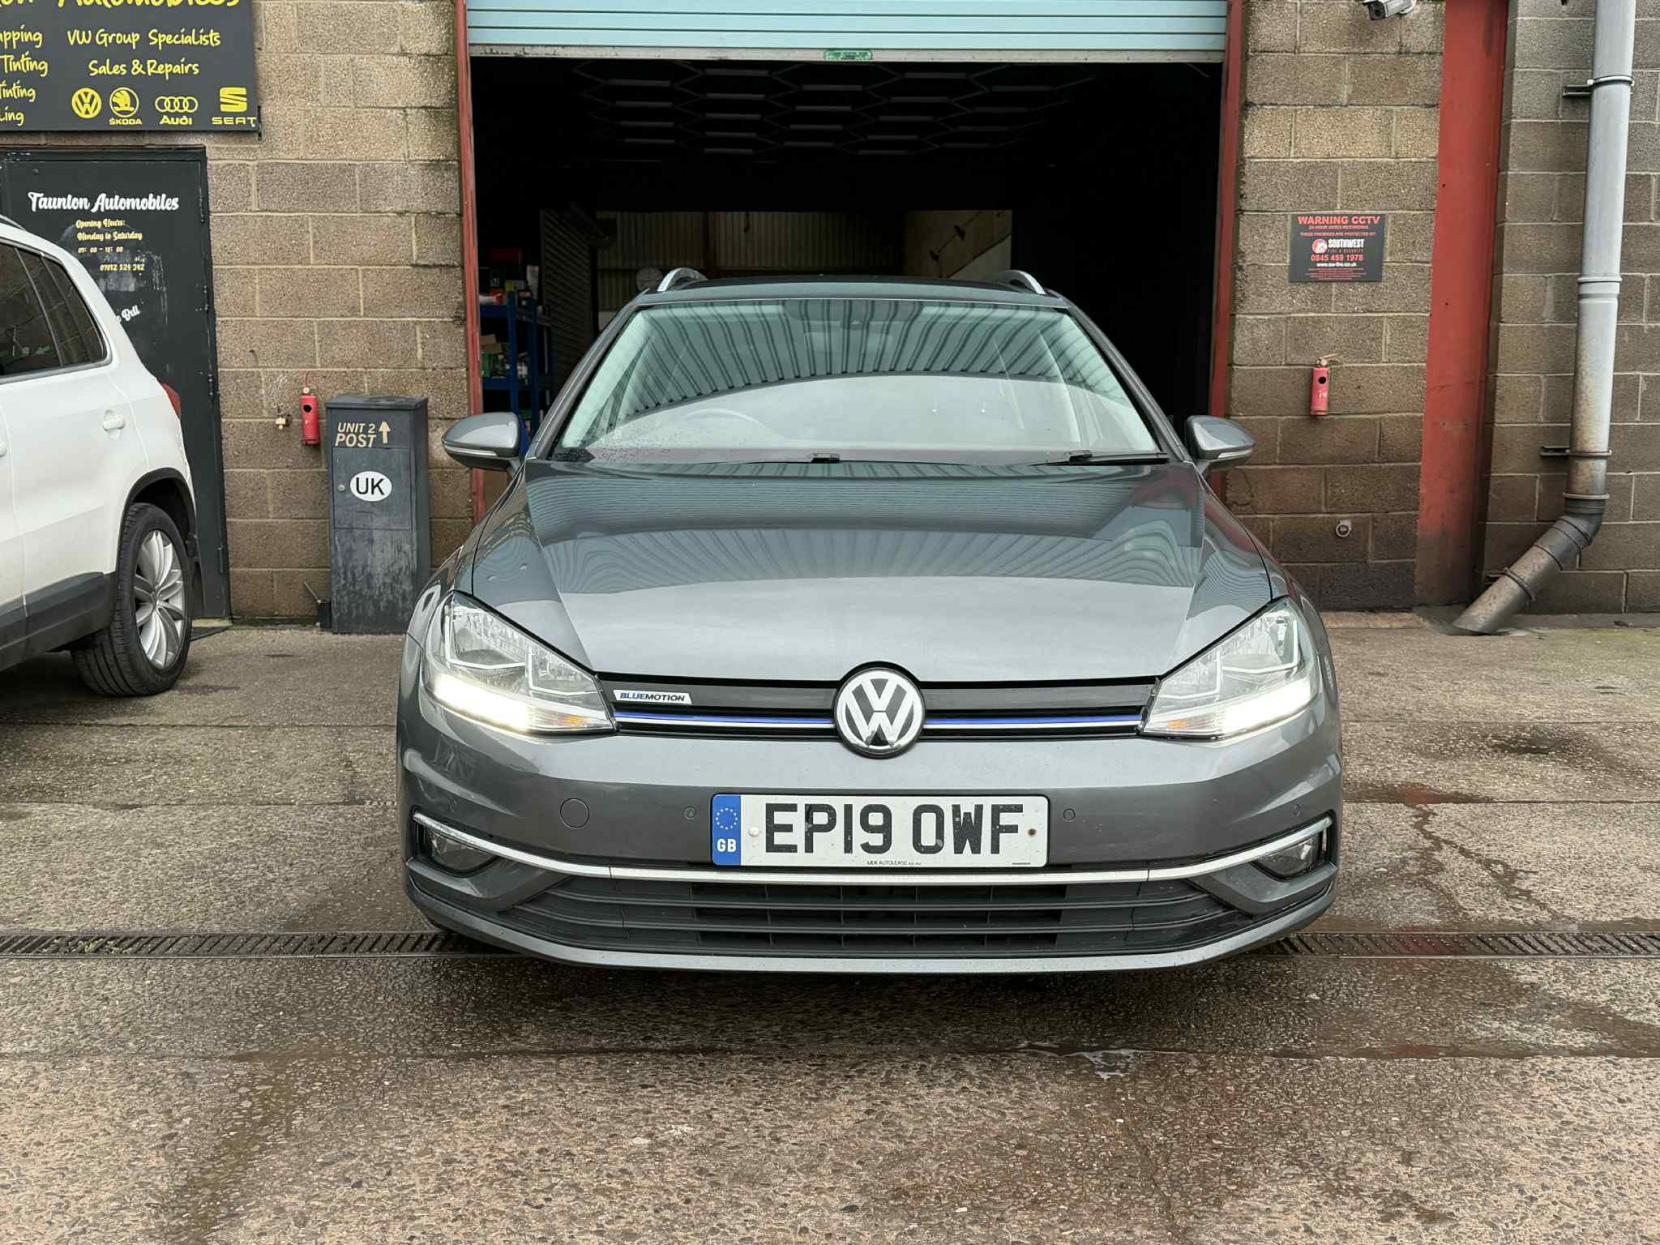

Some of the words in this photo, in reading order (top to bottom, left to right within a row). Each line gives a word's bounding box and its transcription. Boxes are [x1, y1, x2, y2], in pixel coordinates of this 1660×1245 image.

[67, 30, 91, 45] VW
[95, 28, 140, 49] Group
[148, 27, 221, 50] Specialists
[88, 59, 127, 76] Sales
[131, 60, 145, 75] &
[147, 57, 200, 79] Repairs
[211, 116, 257, 127] SEAT
[27, 191, 90, 212] Taunton
[91, 193, 180, 213] Automobiles
[1298, 216, 1349, 225] WARNING
[1351, 215, 1380, 225] CCTV
[112, 230, 143, 241] Saturday
[1328, 239, 1365, 248] SOUTHWEST
[1311, 254, 1329, 262] 0845
[338, 422, 365, 433] UNIT
[368, 423, 376, 433] 2
[335, 433, 377, 448] POST
[356, 477, 385, 495] UK
[619, 691, 686, 702] BLUEMOTION
[765, 803, 892, 854] EP19
[912, 804, 1024, 854] OWF
[716, 838, 737, 852] GB
